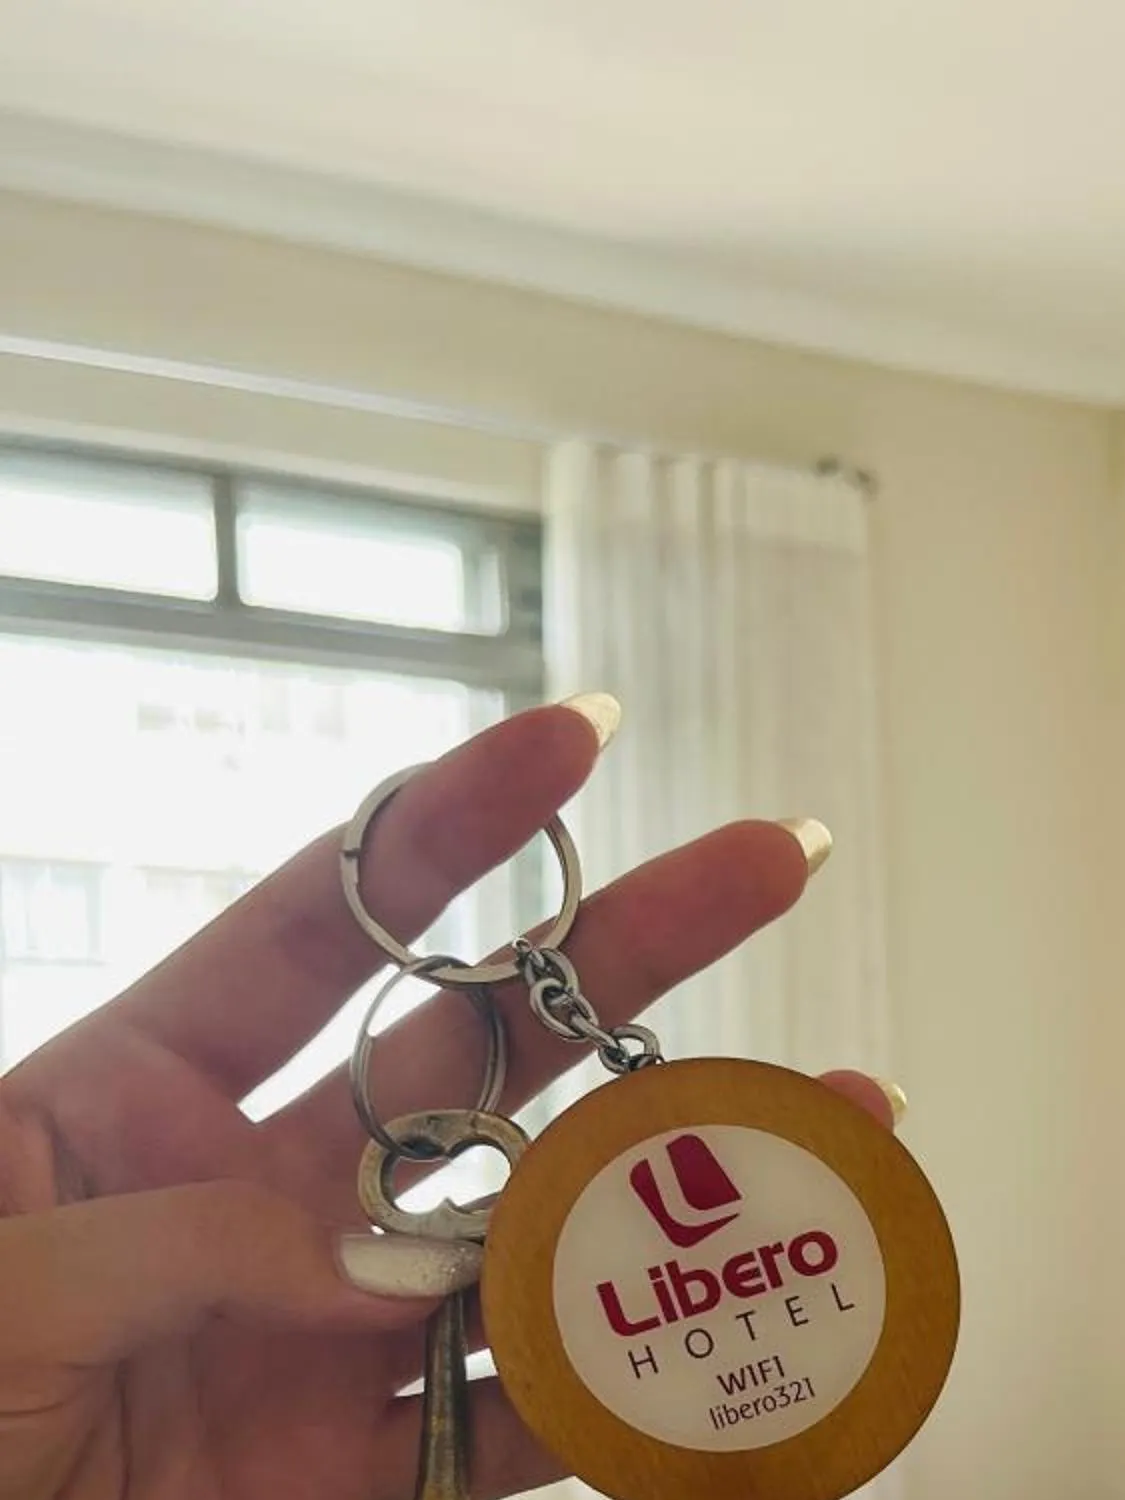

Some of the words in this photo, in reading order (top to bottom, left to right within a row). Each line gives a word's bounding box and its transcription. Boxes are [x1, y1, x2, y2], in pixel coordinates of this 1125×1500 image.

[596, 1230, 838, 1337] Libero
[628, 1284, 854, 1379] HOTEL
[709, 1377, 816, 1430] libero321
[716, 1355, 785, 1396] WIFI
